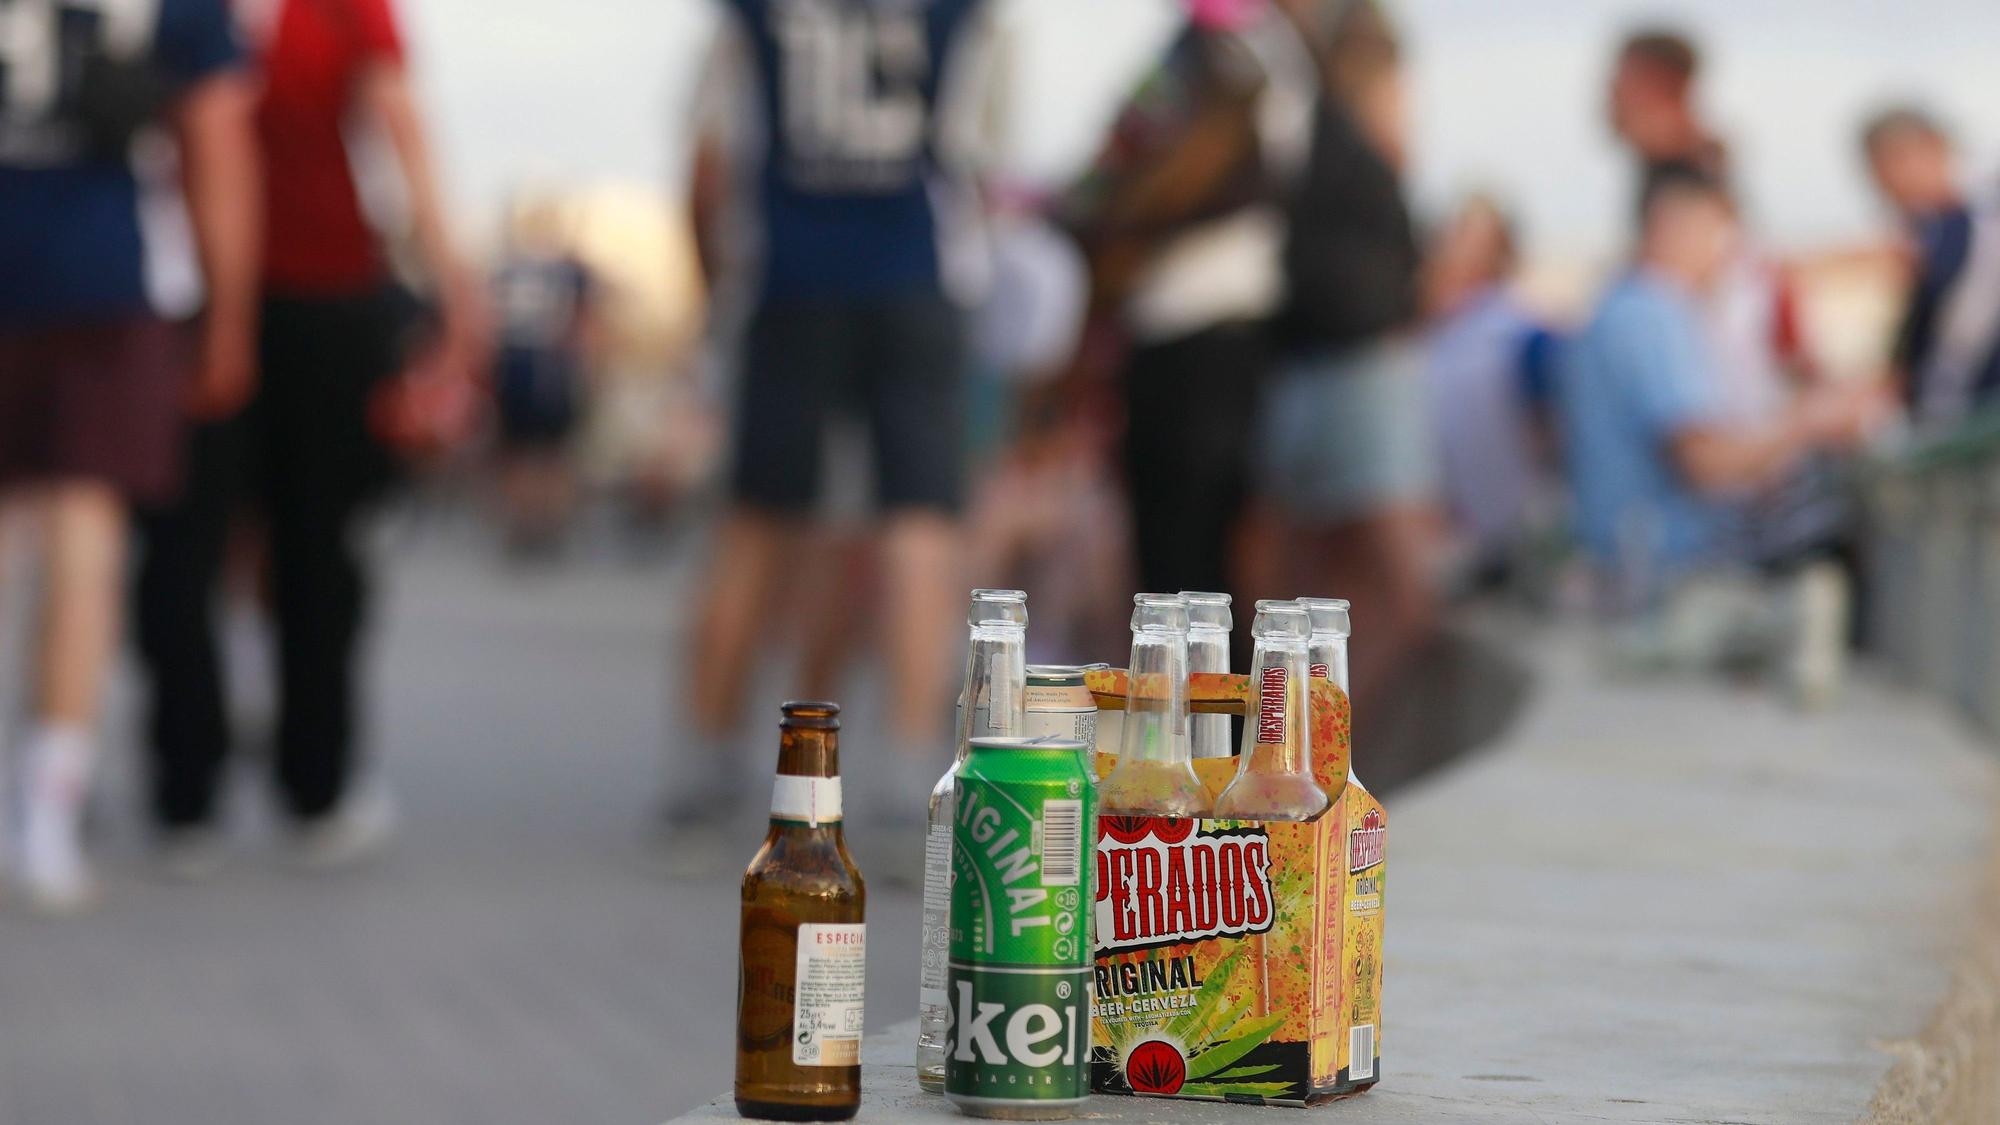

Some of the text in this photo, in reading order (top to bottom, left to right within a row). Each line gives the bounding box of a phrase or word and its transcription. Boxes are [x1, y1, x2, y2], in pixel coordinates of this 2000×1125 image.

[1259, 667, 1287, 743] DESPERADOS
[1094, 955, 1204, 999] RIGINAL
[1090, 994, 1198, 1017] BEER-CERVEZA
[975, 1073, 1052, 1085] LAGER
